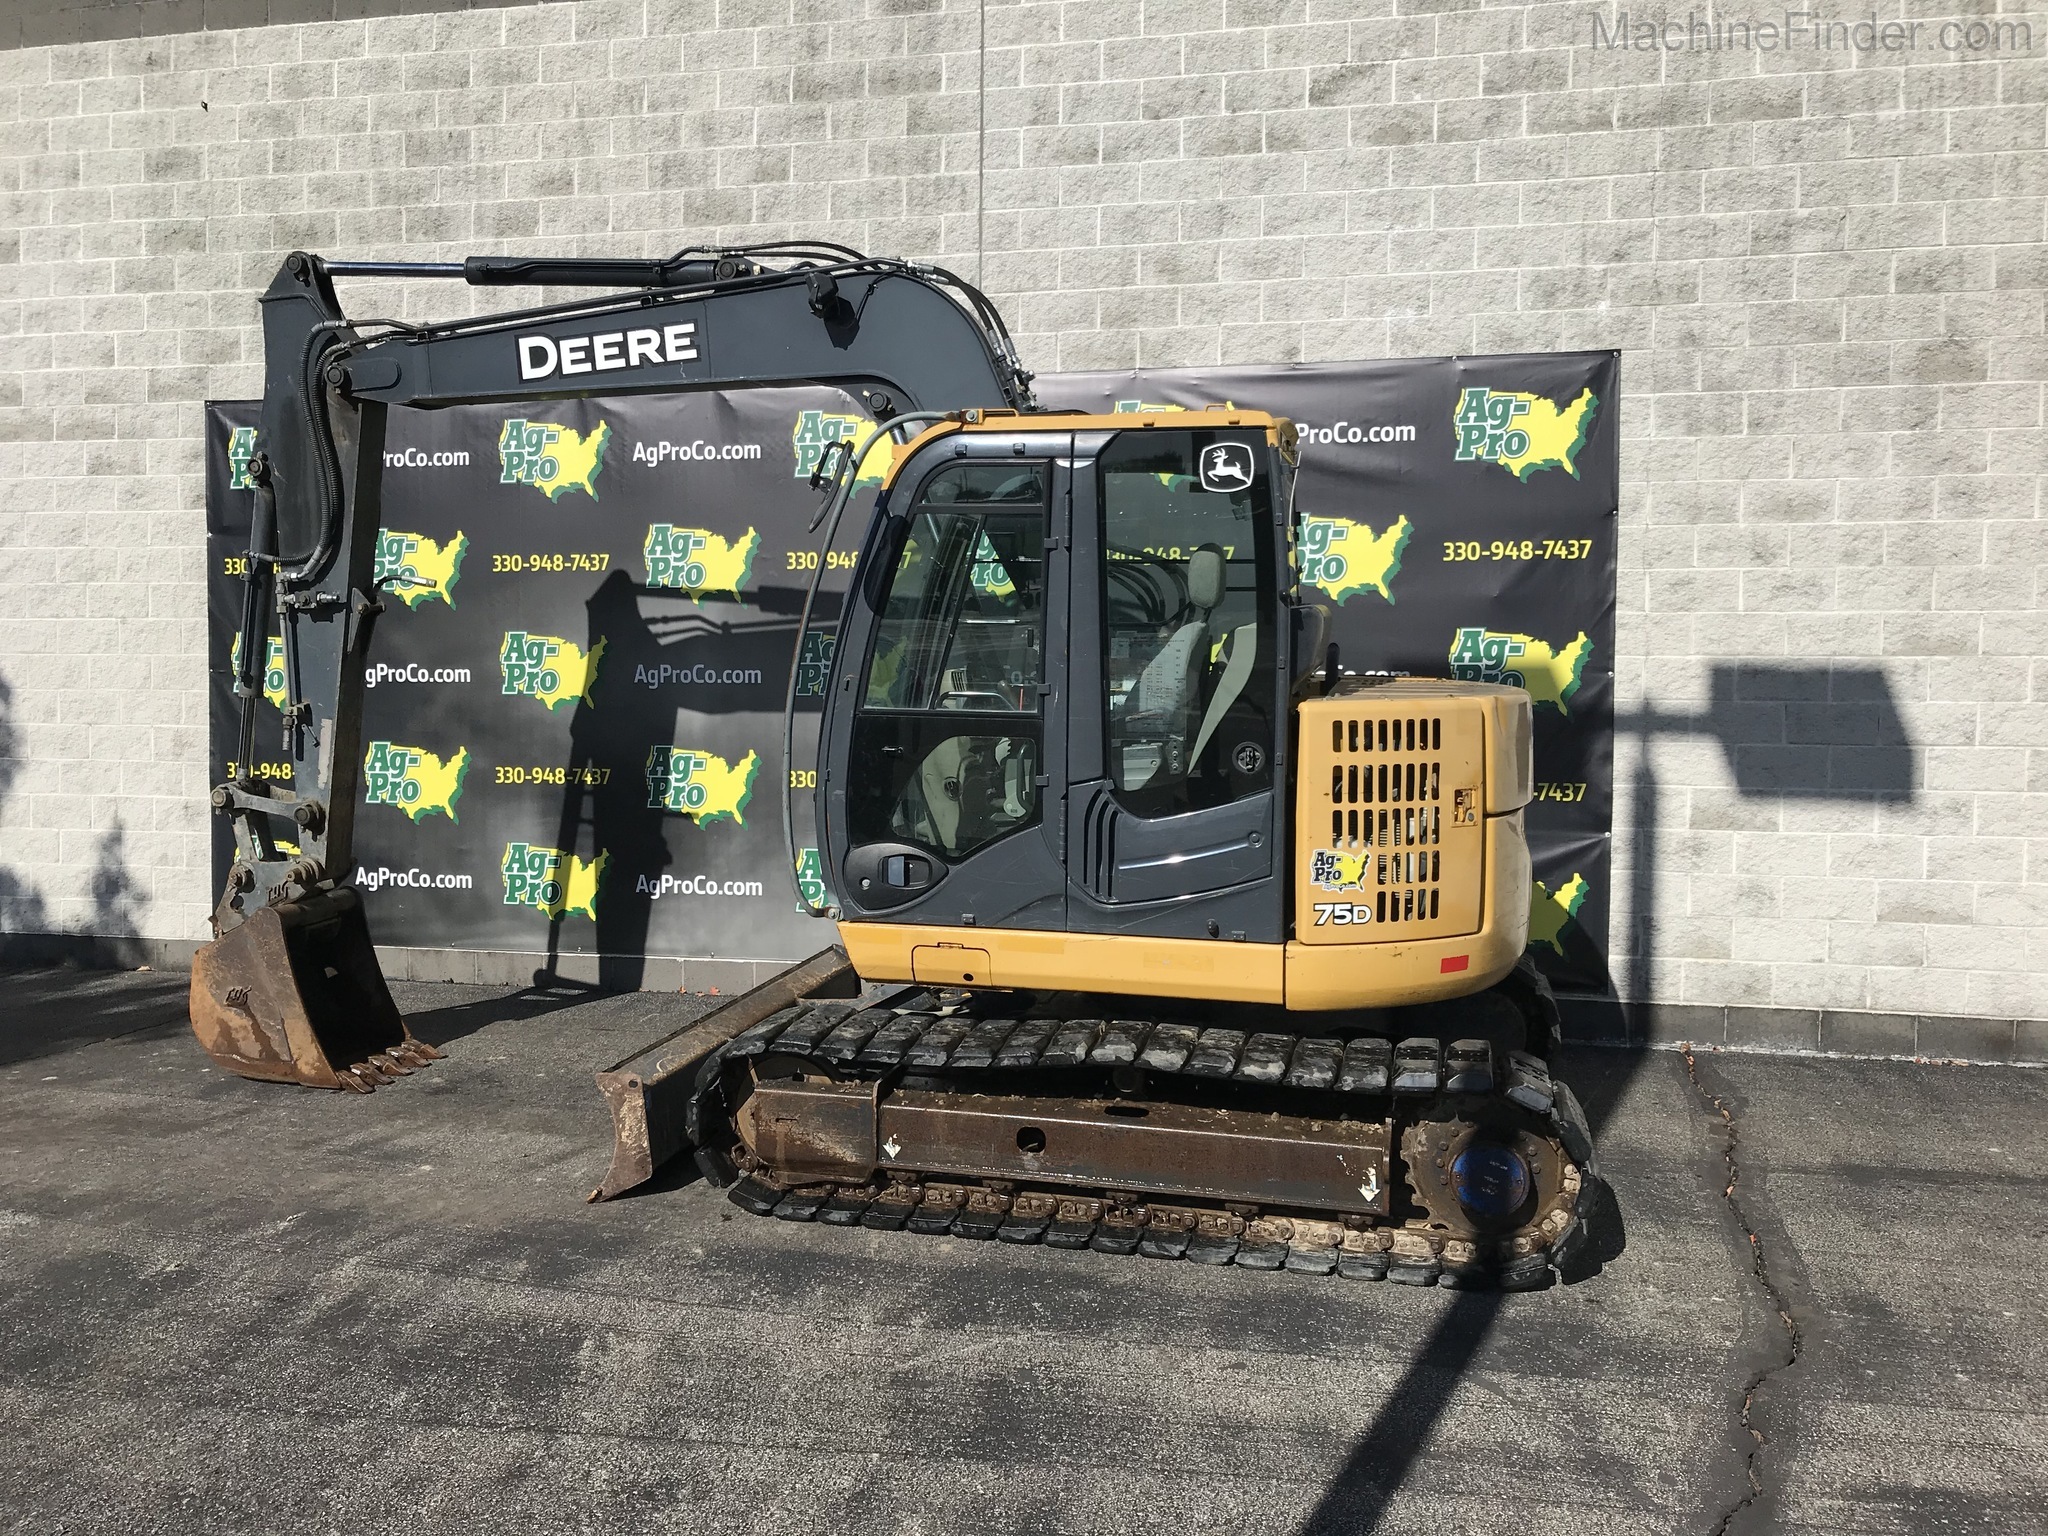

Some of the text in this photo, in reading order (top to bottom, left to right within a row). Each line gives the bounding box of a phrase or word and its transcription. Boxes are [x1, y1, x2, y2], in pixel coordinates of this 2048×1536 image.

[518, 322, 698, 380] DEERE
[1456, 387, 1530, 431] Ag-
[500, 419, 559, 457] Ag-
[632, 440, 762, 467] AgProCo.com
[1455, 423, 1530, 461] Pro
[383, 448, 470, 467] roCo.com
[500, 450, 559, 483] Pro
[646, 524, 706, 562] Ag-
[1442, 539, 1593, 562] 330-948-7437
[492, 554, 611, 573] 330-948-7437
[646, 557, 706, 589] Pro
[501, 631, 559, 669] Ag-
[1451, 628, 1526, 670] Ag-
[502, 663, 560, 695] Pro
[634, 664, 762, 689] AgProCo.com
[368, 741, 421, 778] Ag-
[648, 745, 707, 783] Ag-
[365, 772, 422, 804] Pro
[494, 767, 611, 785] 330-948-7437
[648, 777, 706, 808] Pro
[504, 842, 561, 879] Ag-
[1313, 867, 1342, 882] Pro
[1314, 852, 1342, 869] Ag-
[354, 866, 473, 892] AgProCo.com
[503, 874, 562, 905] Pro
[635, 874, 763, 900] AgProCo.com
[1313, 902, 1372, 926] 75D
